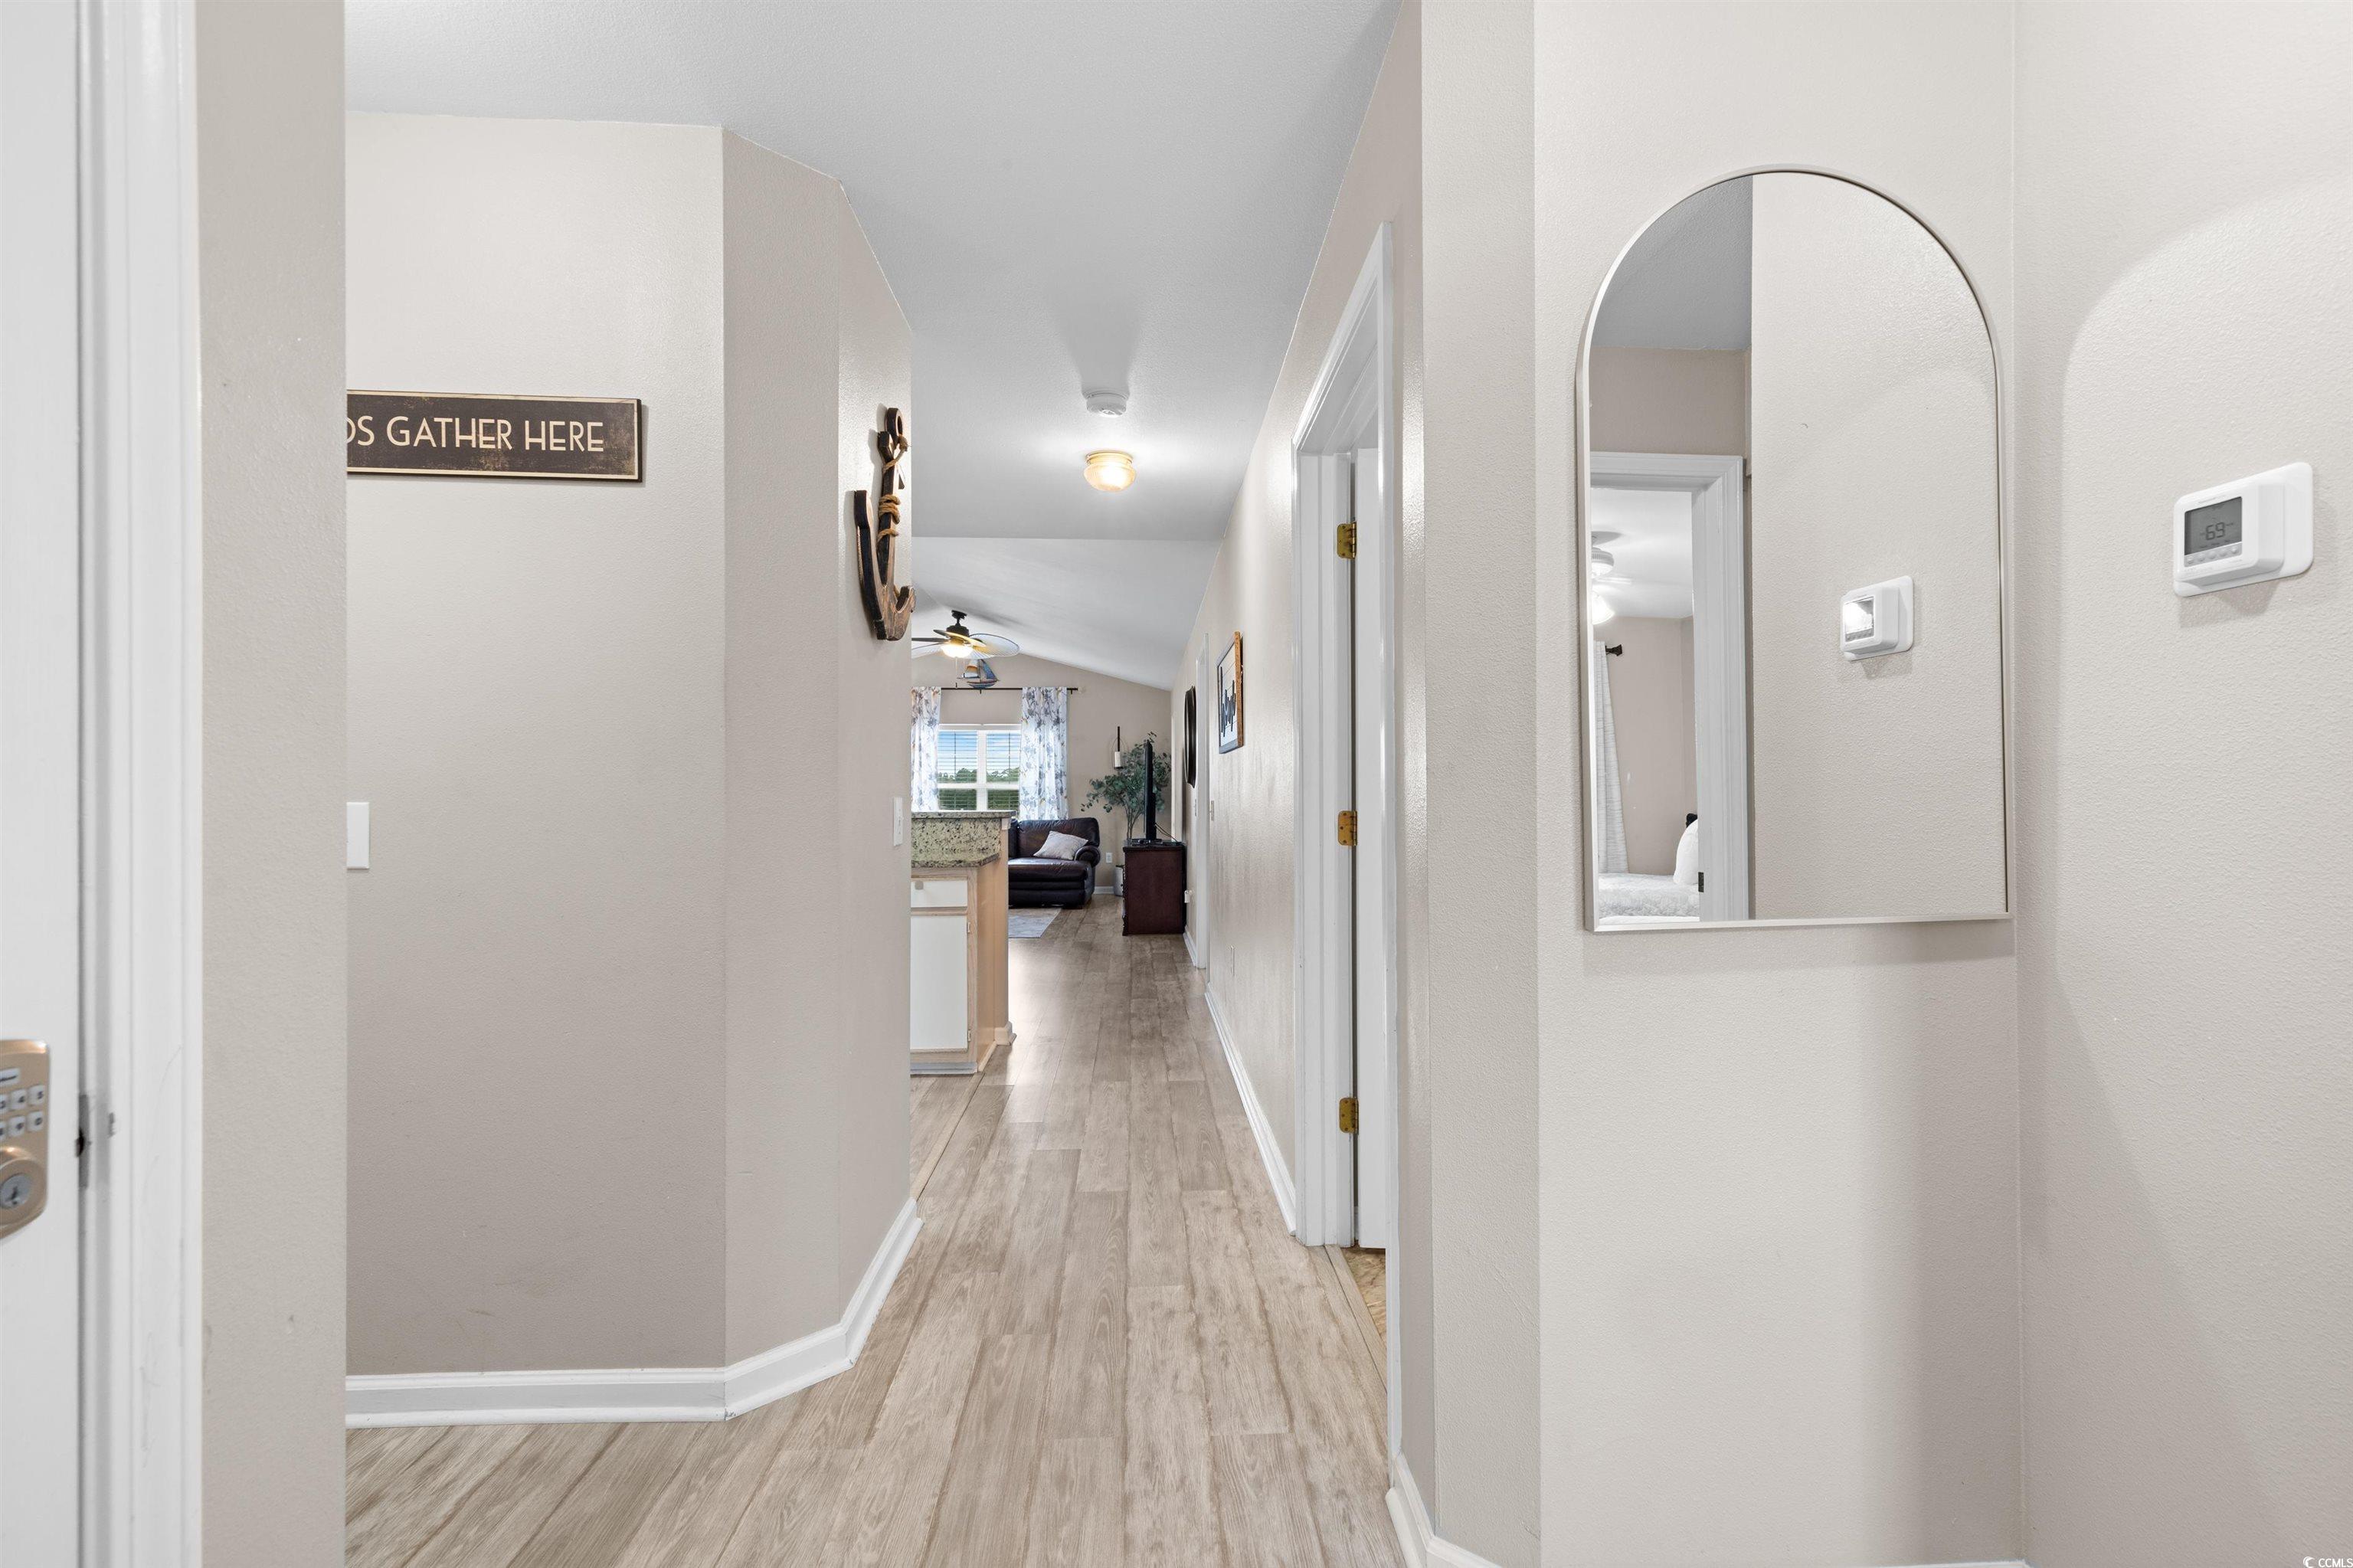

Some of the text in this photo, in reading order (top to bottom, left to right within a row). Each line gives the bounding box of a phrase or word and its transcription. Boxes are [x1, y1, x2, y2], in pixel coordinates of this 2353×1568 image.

[386, 416, 512, 451] GATHER
[525, 420, 604, 452] HERE
[2206, 522, 2225, 540] 69
